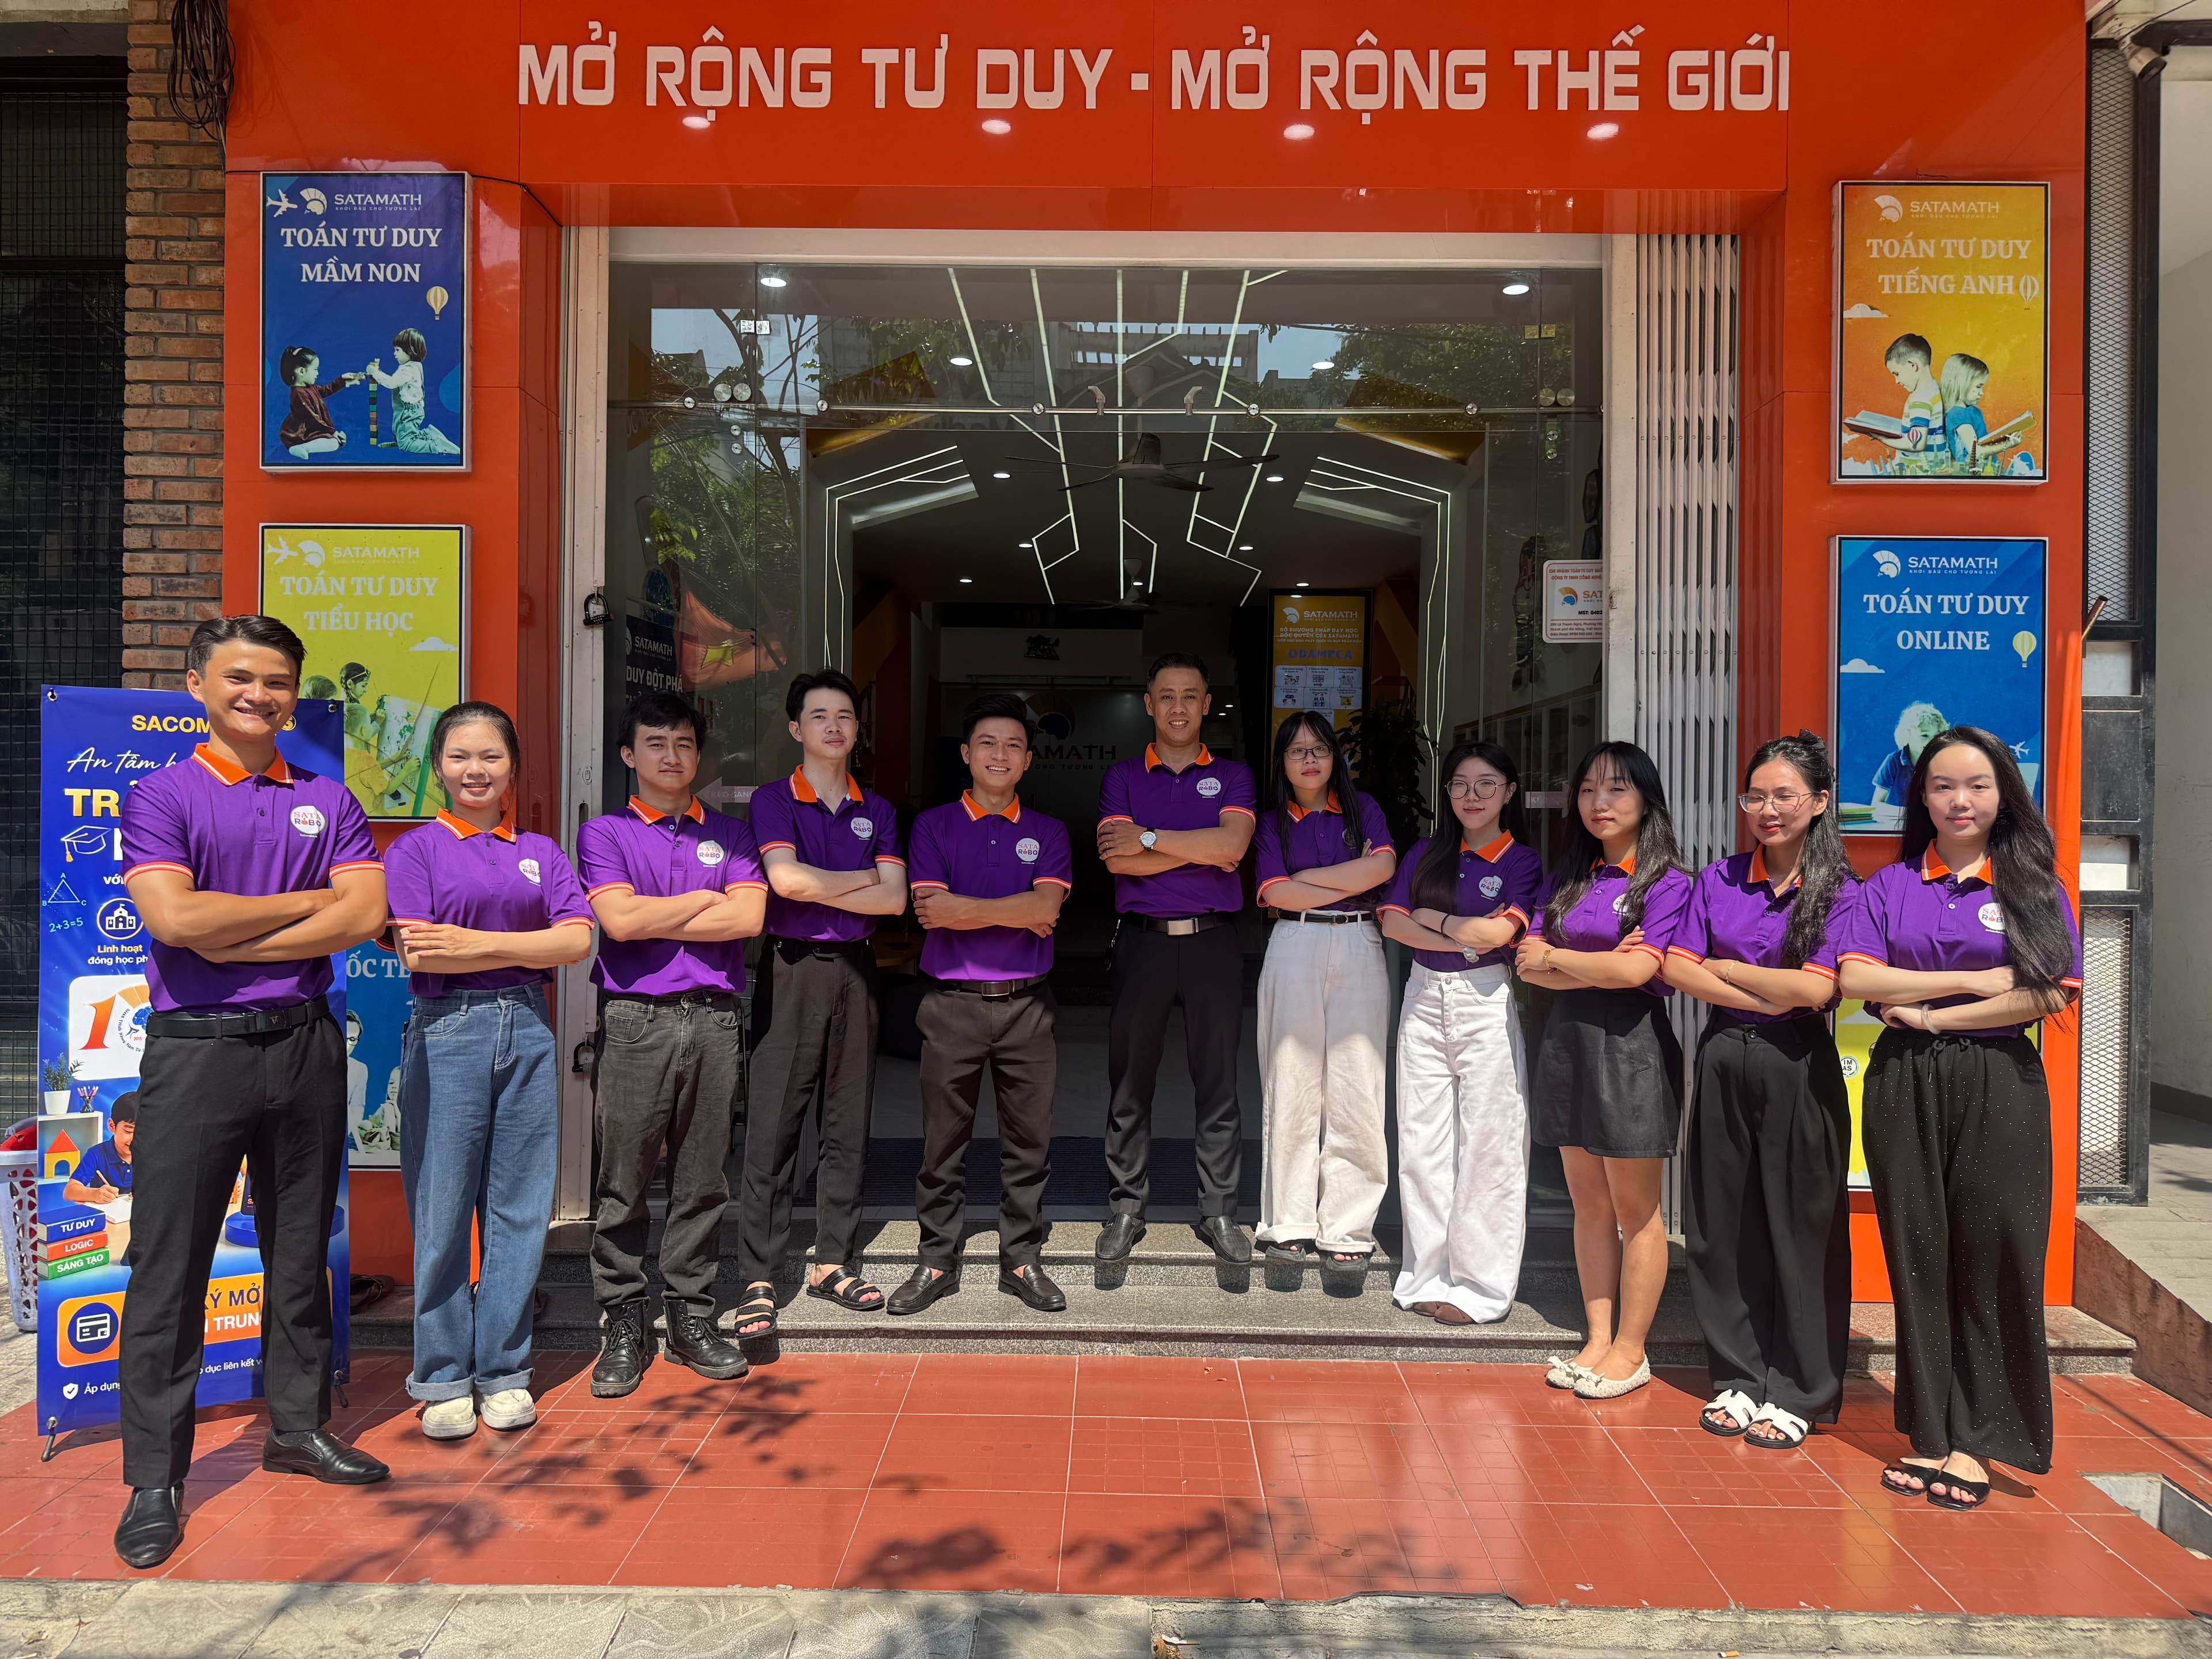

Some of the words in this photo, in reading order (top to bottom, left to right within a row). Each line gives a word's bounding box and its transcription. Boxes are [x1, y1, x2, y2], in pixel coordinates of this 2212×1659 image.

[518, 21, 616, 105] MỞ
[646, 25, 832, 121] RỘNG
[861, 33, 948, 109] TƯ
[976, 48, 1113, 110] DUY
[1171, 26, 1270, 111] MỞ
[1300, 29, 1486, 125] RỘNG
[1514, 24, 1645, 111] THẾ
[1668, 33, 1789, 111] GIỚI
[334, 194, 422, 206] SATAMATH
[1910, 200, 1999, 213] SATAMATH
[281, 221, 347, 247] TOÁN
[353, 225, 388, 247] TƯ
[391, 228, 442, 247] DUY
[1866, 232, 1936, 258] TOÁN
[1941, 237, 1976, 258] TƯ
[1980, 240, 2032, 259] DUY
[301, 255, 362, 282] MẦM
[368, 263, 421, 282] NON
[1878, 267, 1955, 294] TIẾNG
[1960, 275, 2014, 295] ANH
[332, 547, 420, 559] SATAMATH
[1908, 556, 1998, 569] SATAMATH
[280, 570, 346, 596] TOÁN
[351, 575, 385, 596] TƯ
[390, 578, 438, 596] DUY
[1583, 590, 1603, 599] SAT
[1863, 587, 1932, 613] TOÁN
[1938, 593, 1972, 614] TƯ
[1978, 596, 2029, 615] DUY
[304, 603, 359, 631] TIỂU
[365, 612, 414, 637] HỌC
[635, 636, 672, 657] SATAMATH
[1897, 630, 1990, 650] ONLINE
[626, 665, 645, 684] DUY
[646, 668, 664, 691] ĐỘT
[666, 674, 683, 693] PHÁ
[132, 715, 210, 733] SACOM
[67, 747, 113, 772] An
[115, 750, 161, 774] tâm
[1032, 745, 1116, 760] AMATH
[294, 811, 321, 820] SATA
[294, 818, 321, 827] ROBO
[1982, 914, 2004, 923] ROB
[97, 945, 119, 953] Linh
[121, 944, 143, 954] hoạt
[88, 956, 113, 965] đóng
[116, 956, 134, 965] học
[137, 955, 148, 965] ph
[346, 950, 377, 978] ỐC
[60, 1222, 74, 1233] TƯ
[76, 1218, 96, 1230] DUY
[65, 1239, 94, 1253] LOGIC
[56, 1259, 84, 1272] SÁNG
[85, 1254, 104, 1265] TẠO
[204, 1288, 222, 1309] Ý
[229, 1282, 260, 1307] MỞ
[213, 1312, 262, 1332] TRUN
[205, 1365, 222, 1374] dục
[224, 1361, 239, 1370] liên
[241, 1358, 255, 1368] kết
